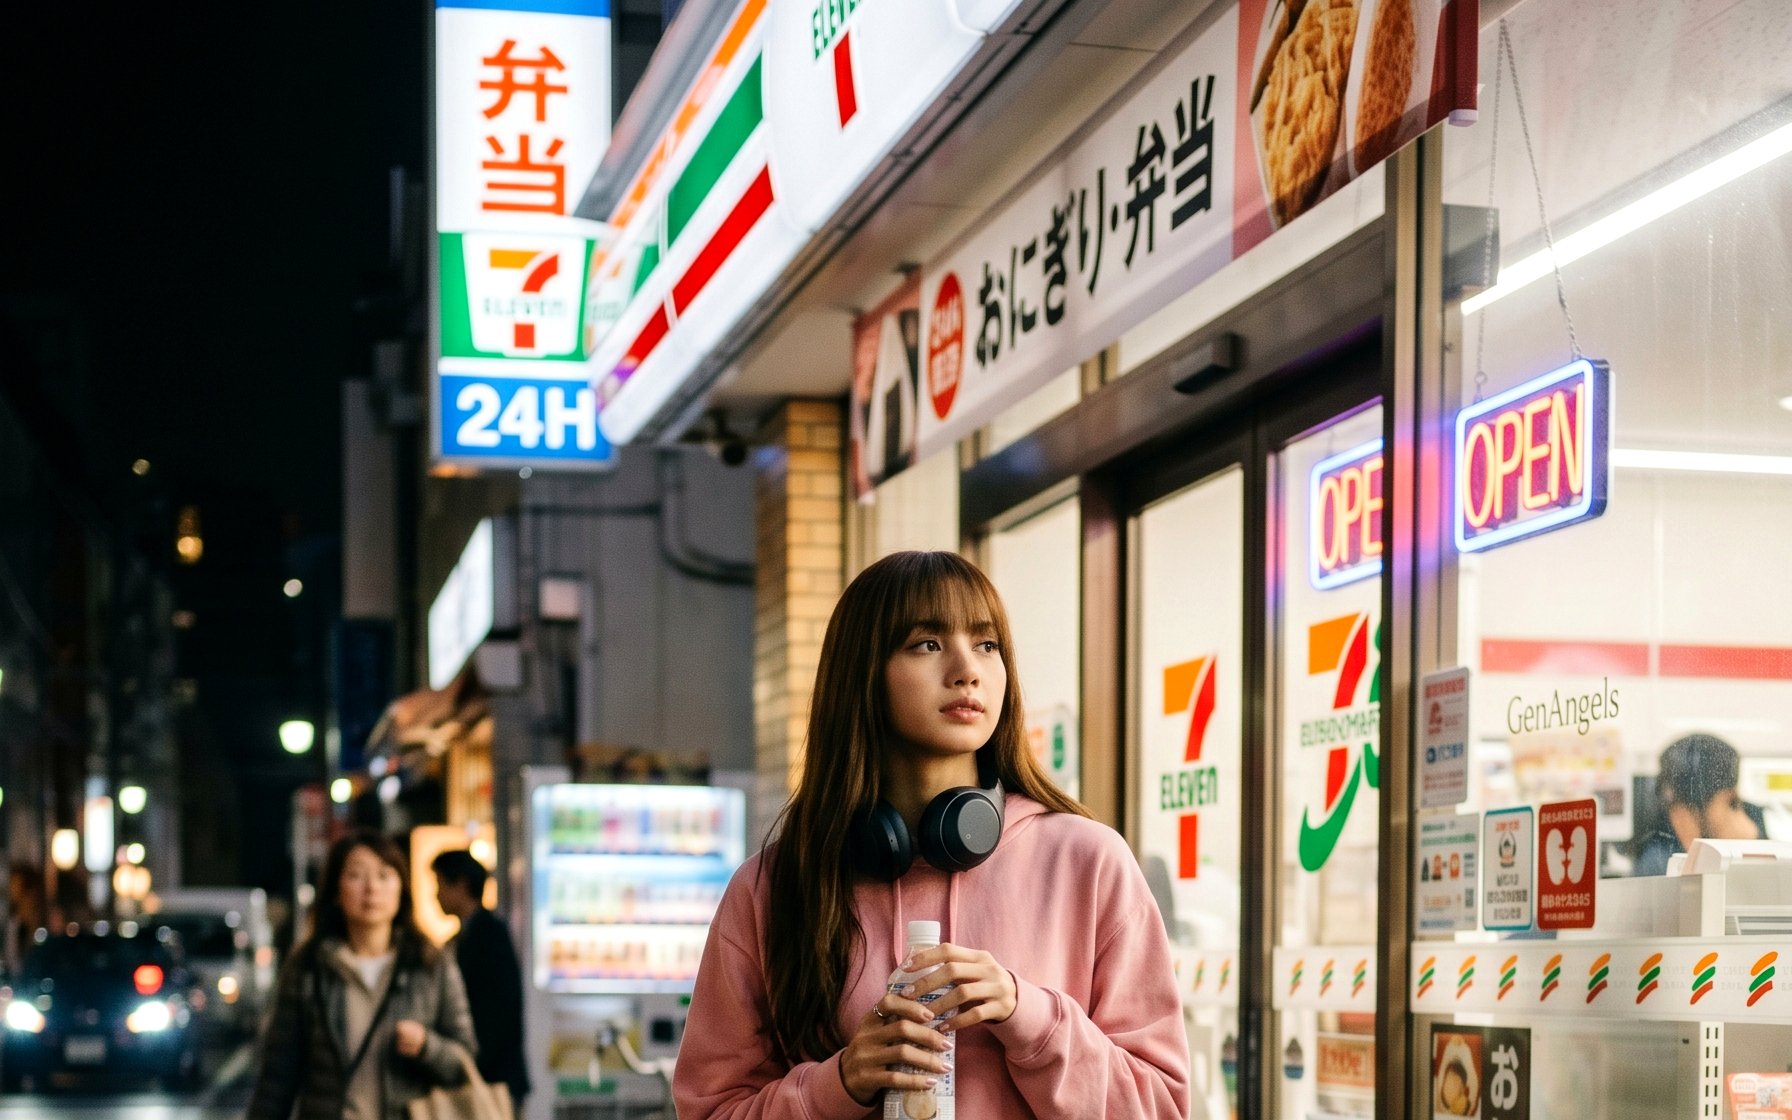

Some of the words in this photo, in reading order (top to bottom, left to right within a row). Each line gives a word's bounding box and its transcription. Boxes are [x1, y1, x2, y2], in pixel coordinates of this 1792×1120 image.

[479, 38, 569, 216] 弁当
[456, 382, 597, 450] 24H
[1463, 382, 1585, 528] OPEN
[1319, 456, 1384, 571] OPE
[1507, 676, 1619, 736] GenAngels
